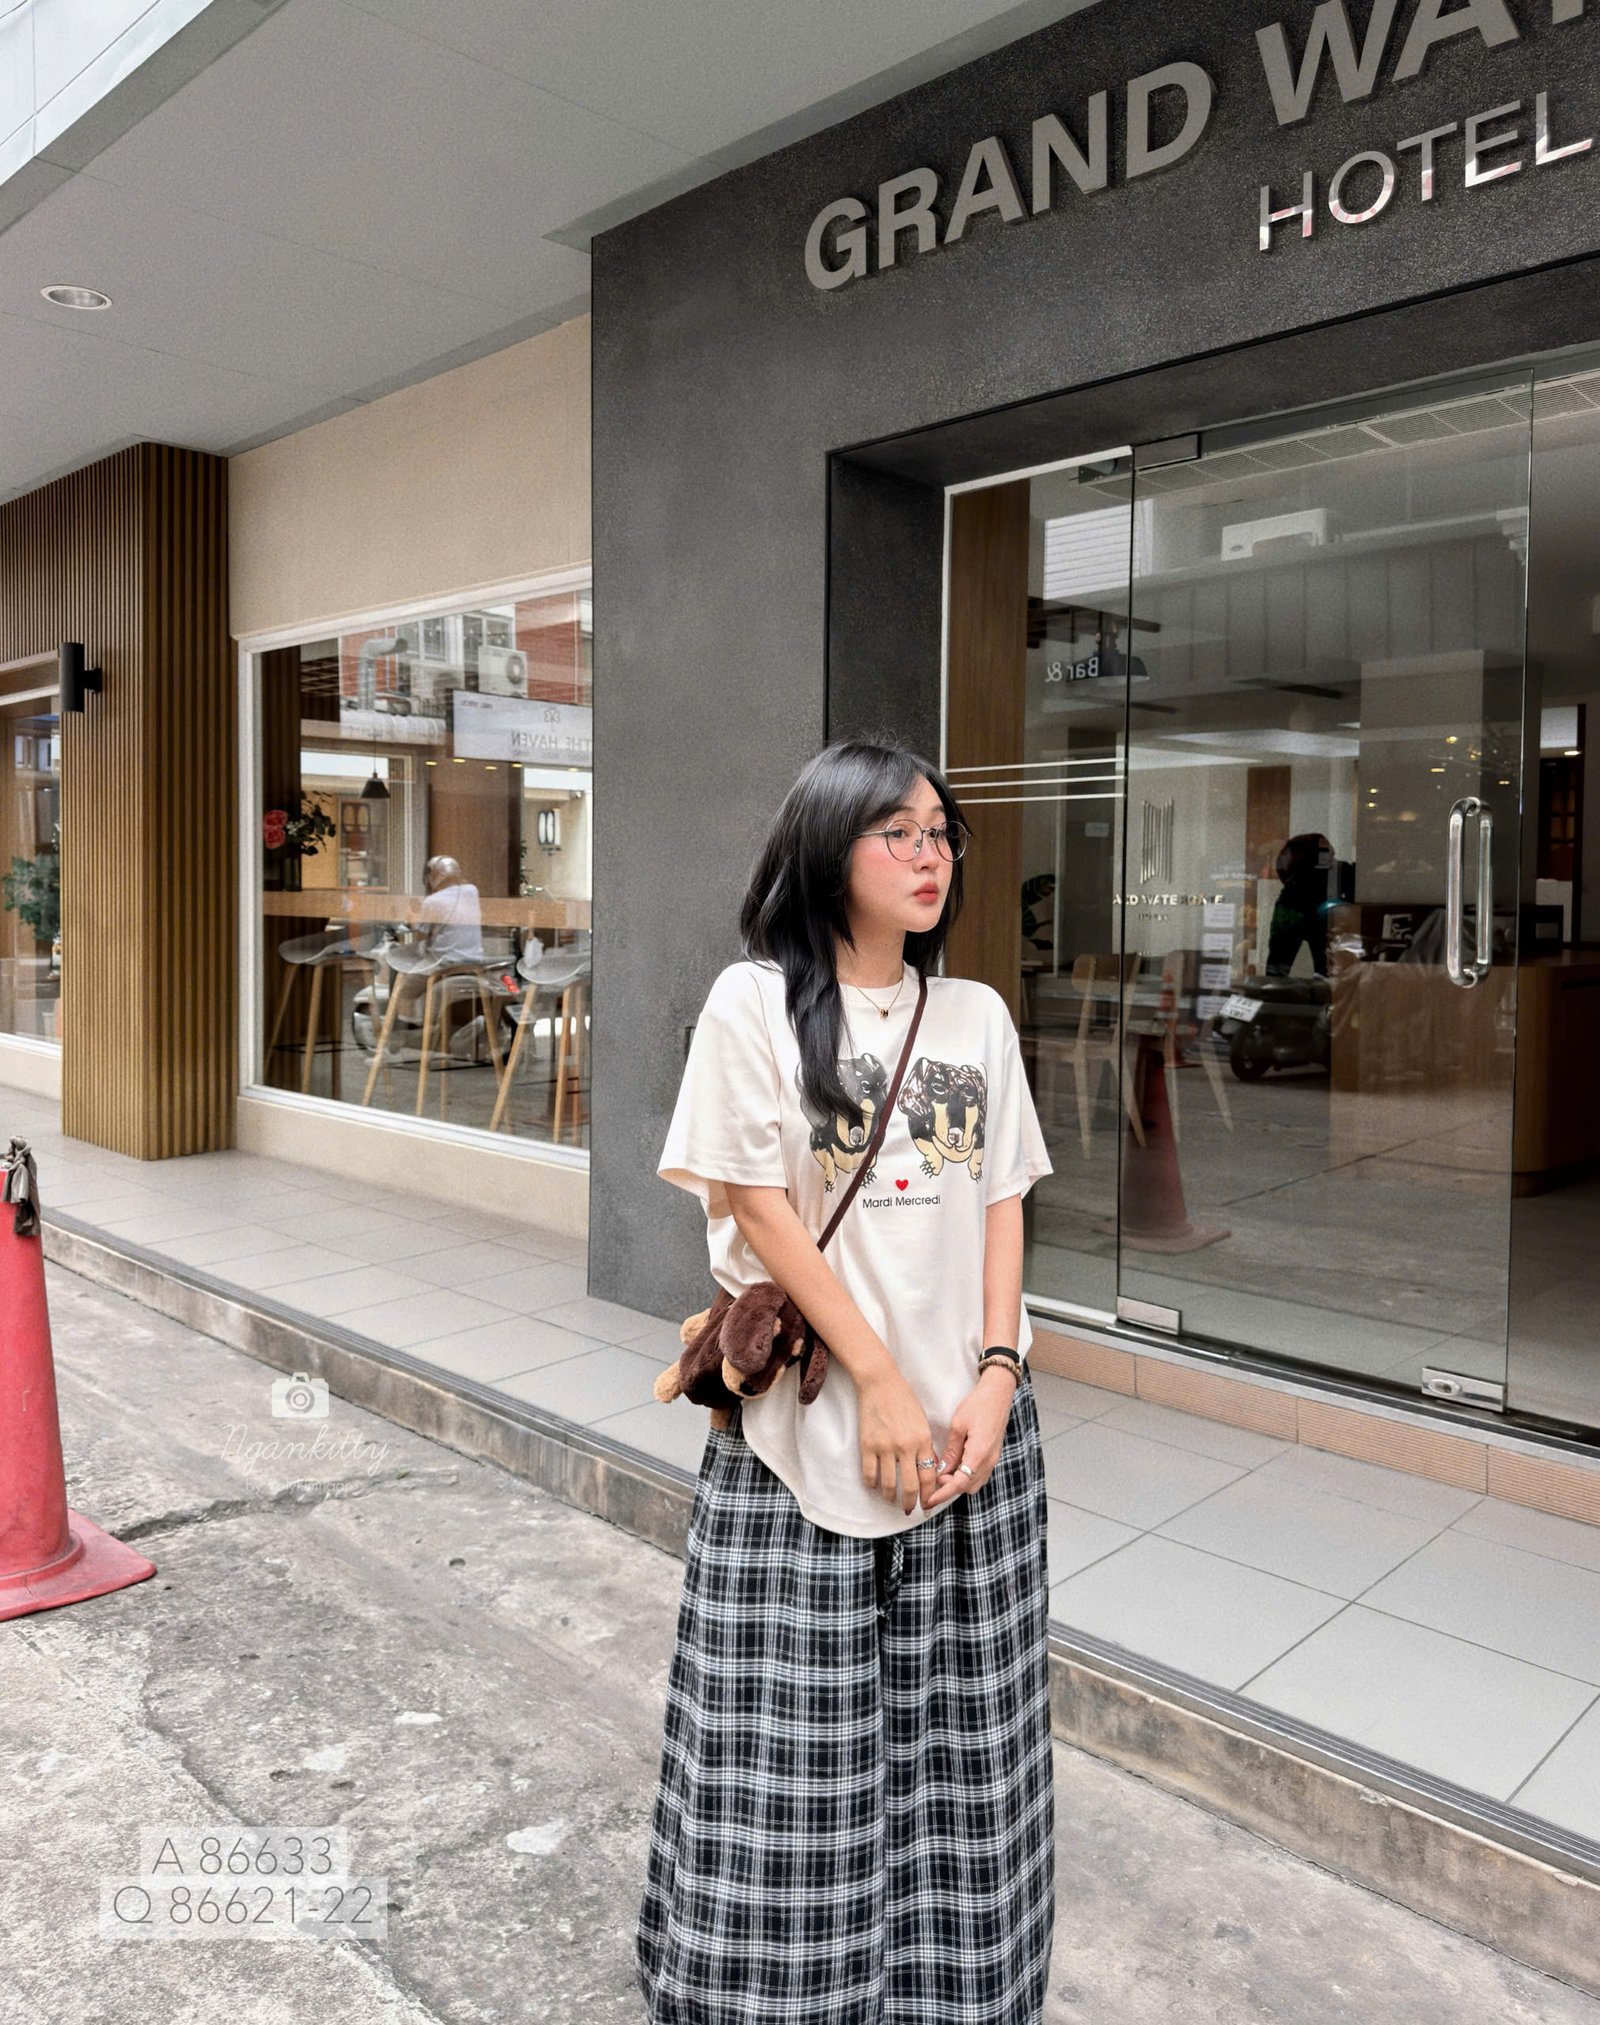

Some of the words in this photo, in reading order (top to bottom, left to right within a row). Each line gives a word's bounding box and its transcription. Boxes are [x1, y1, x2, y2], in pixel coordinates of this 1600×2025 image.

[804, 61, 1219, 291] GRAND
[1255, 0, 1584, 126] WA
[1259, 91, 1593, 251] HOTEL
[862, 1197, 893, 1209] Mardi
[895, 1195, 941, 1207] Mercredi
